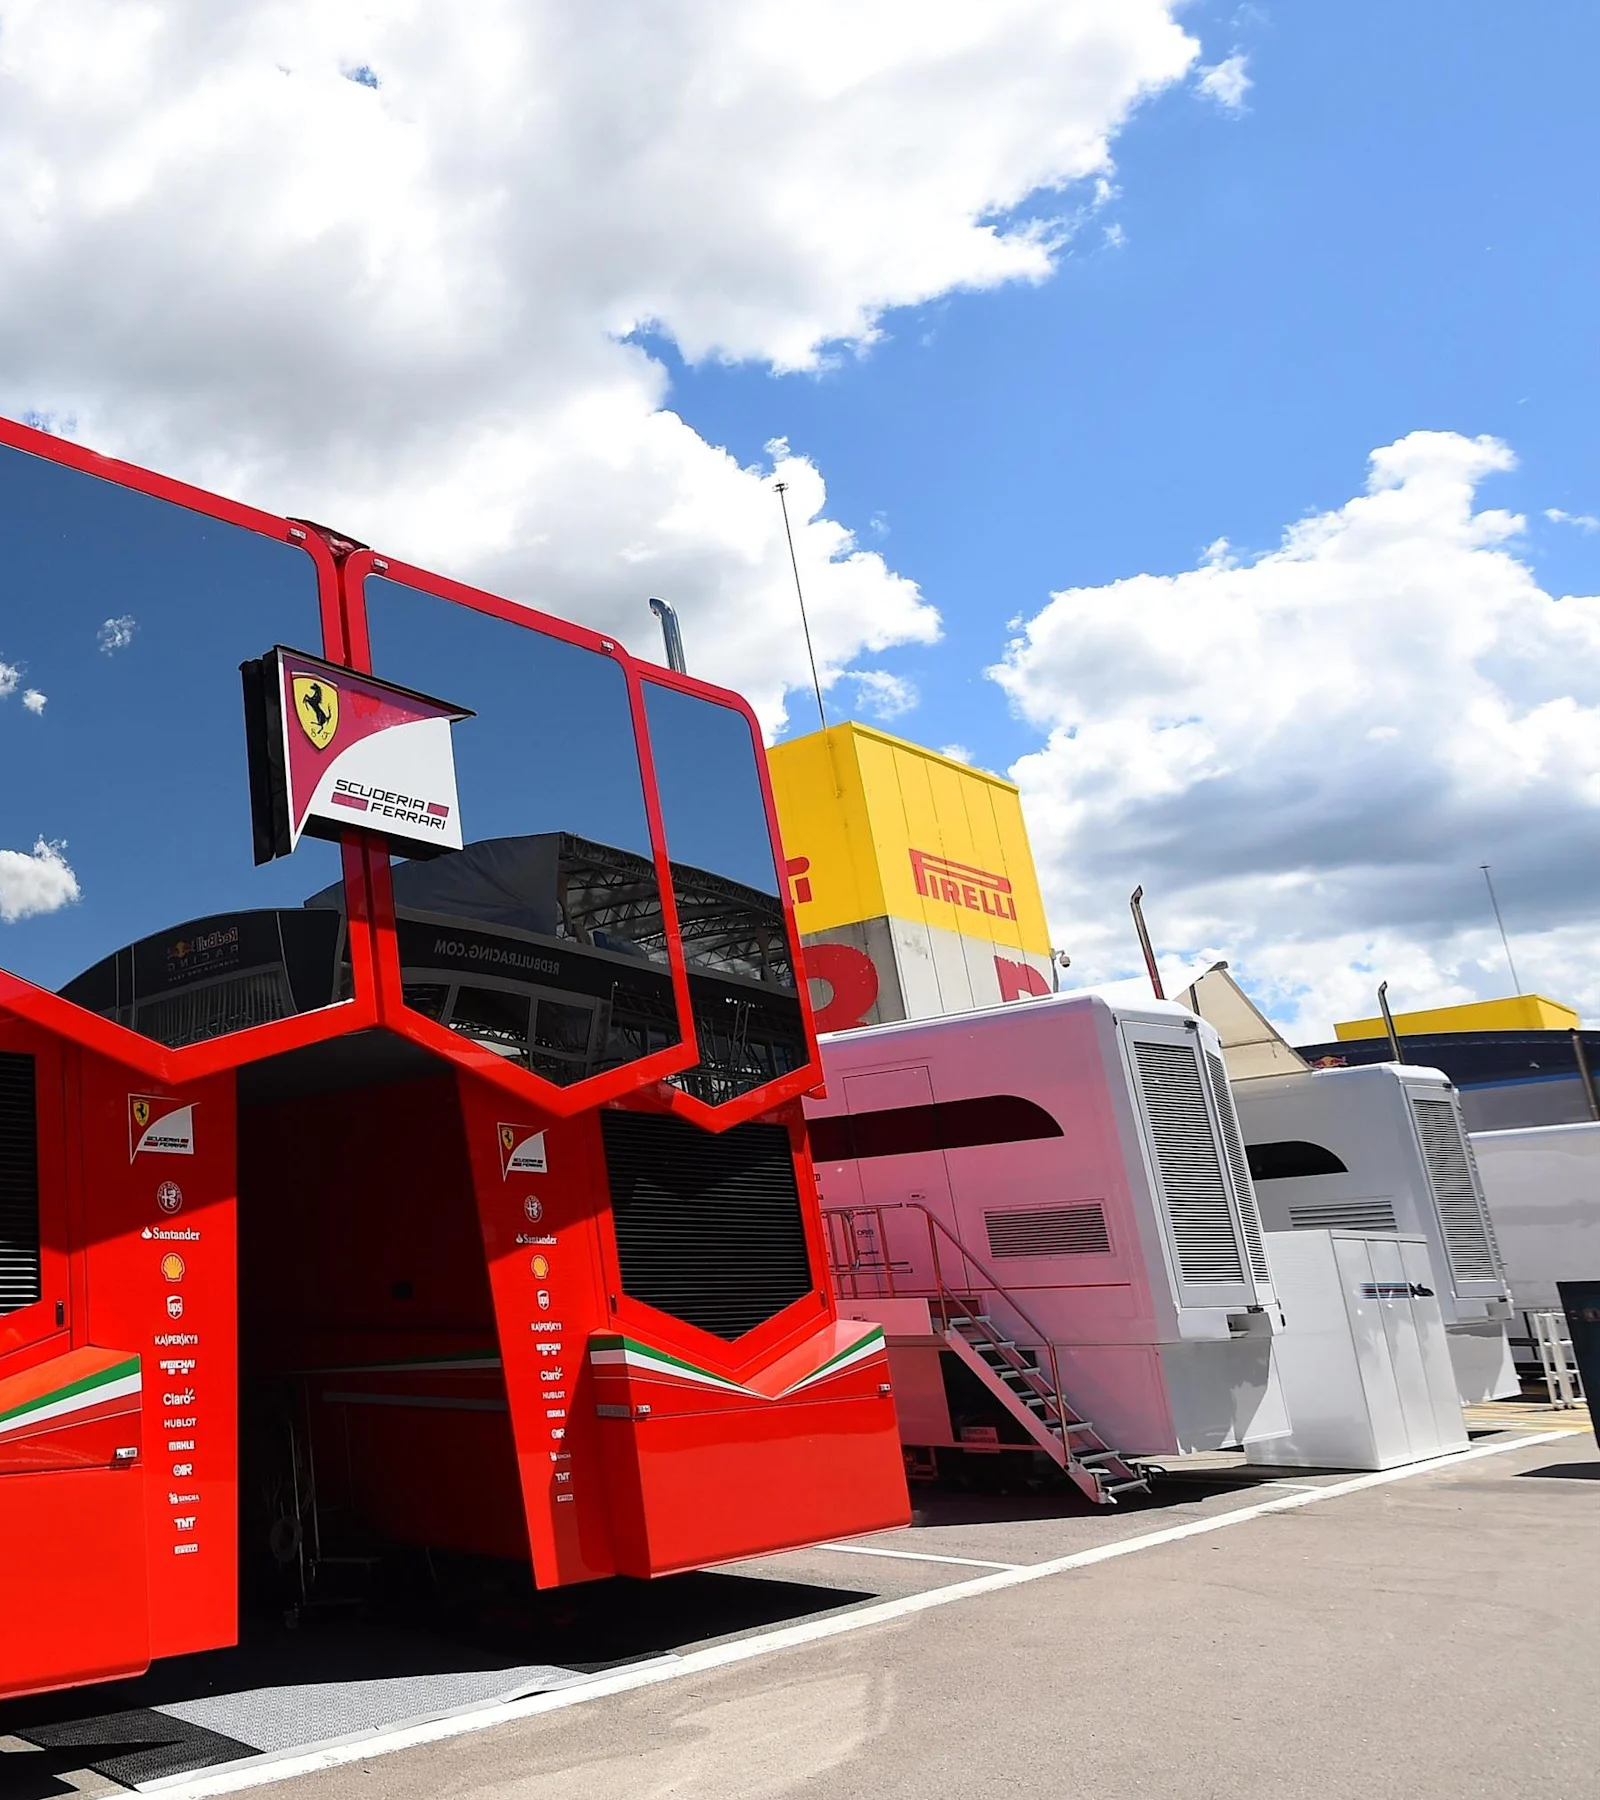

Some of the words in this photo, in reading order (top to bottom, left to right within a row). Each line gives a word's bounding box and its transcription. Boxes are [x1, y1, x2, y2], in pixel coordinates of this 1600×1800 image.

[334, 779, 426, 811] SCUDERIA
[369, 802, 447, 831] FERRARI
[908, 848, 1018, 921] PIRELLI
[152, 1226, 201, 1241] Santander
[523, 1233, 558, 1245] Santander
[164, 1417, 197, 1429] HUBLOT
[174, 1516, 197, 1530] TNT
